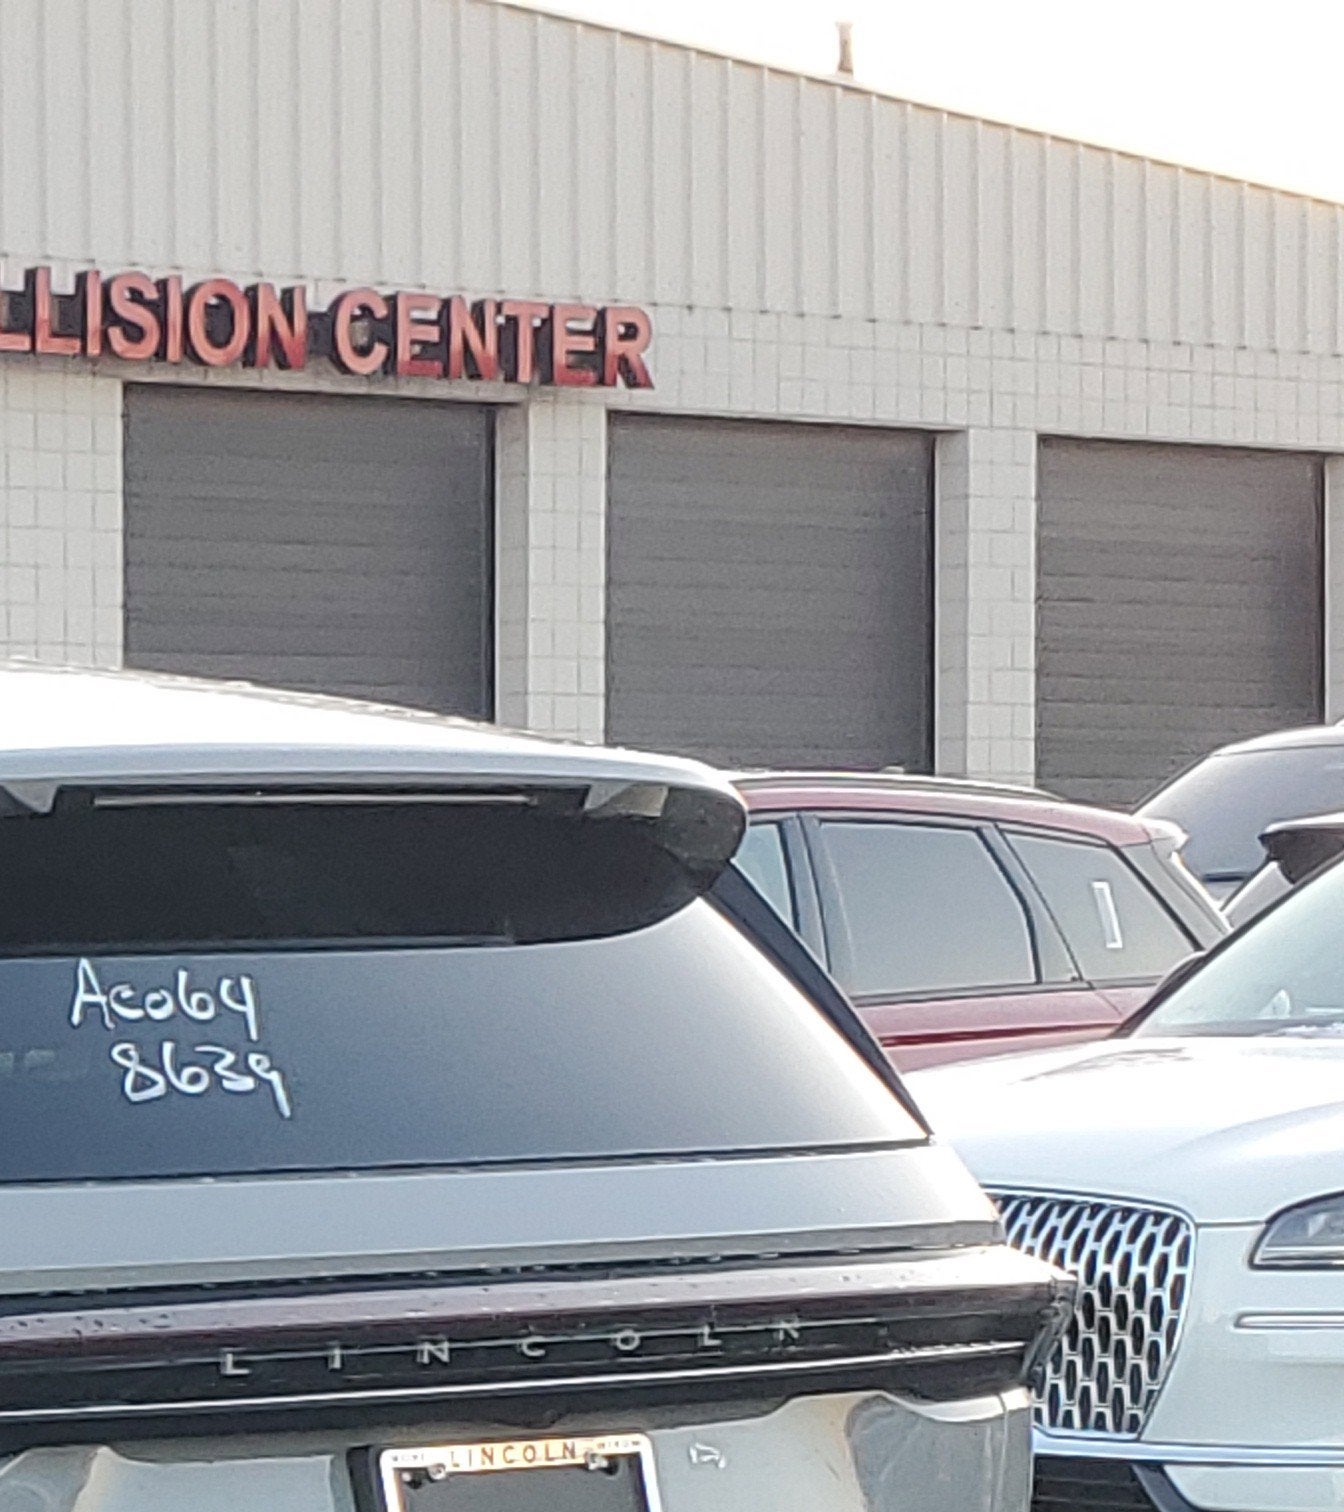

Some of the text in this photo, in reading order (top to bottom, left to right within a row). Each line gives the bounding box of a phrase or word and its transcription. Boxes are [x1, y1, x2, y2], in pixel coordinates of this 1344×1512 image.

[332, 286, 655, 390] CENTER
[220, 1319, 799, 1376] LINCOLN
[449, 1441, 577, 1468] LINCOLN
